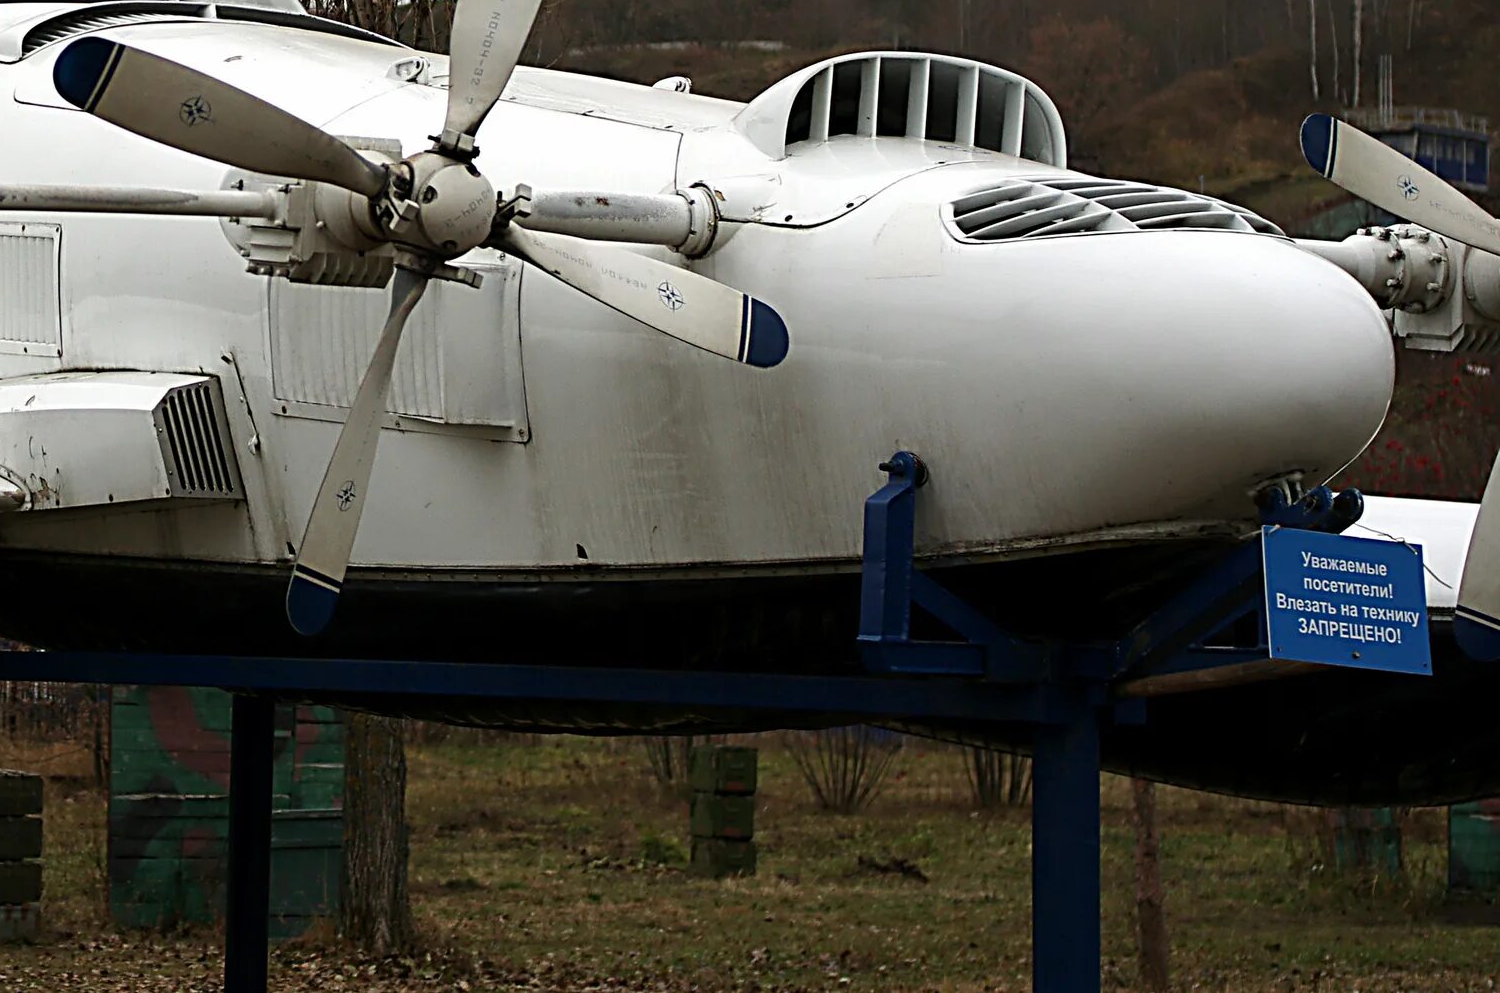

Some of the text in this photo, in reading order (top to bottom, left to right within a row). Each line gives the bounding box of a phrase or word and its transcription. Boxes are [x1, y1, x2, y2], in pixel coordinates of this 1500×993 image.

[1301, 551, 1388, 576] Уважаемые
[1303, 577, 1393, 599] посетители!
[1275, 593, 1420, 628] Влезать на технику
[1298, 618, 1402, 644] ЗАПРЕЩЕНО!
